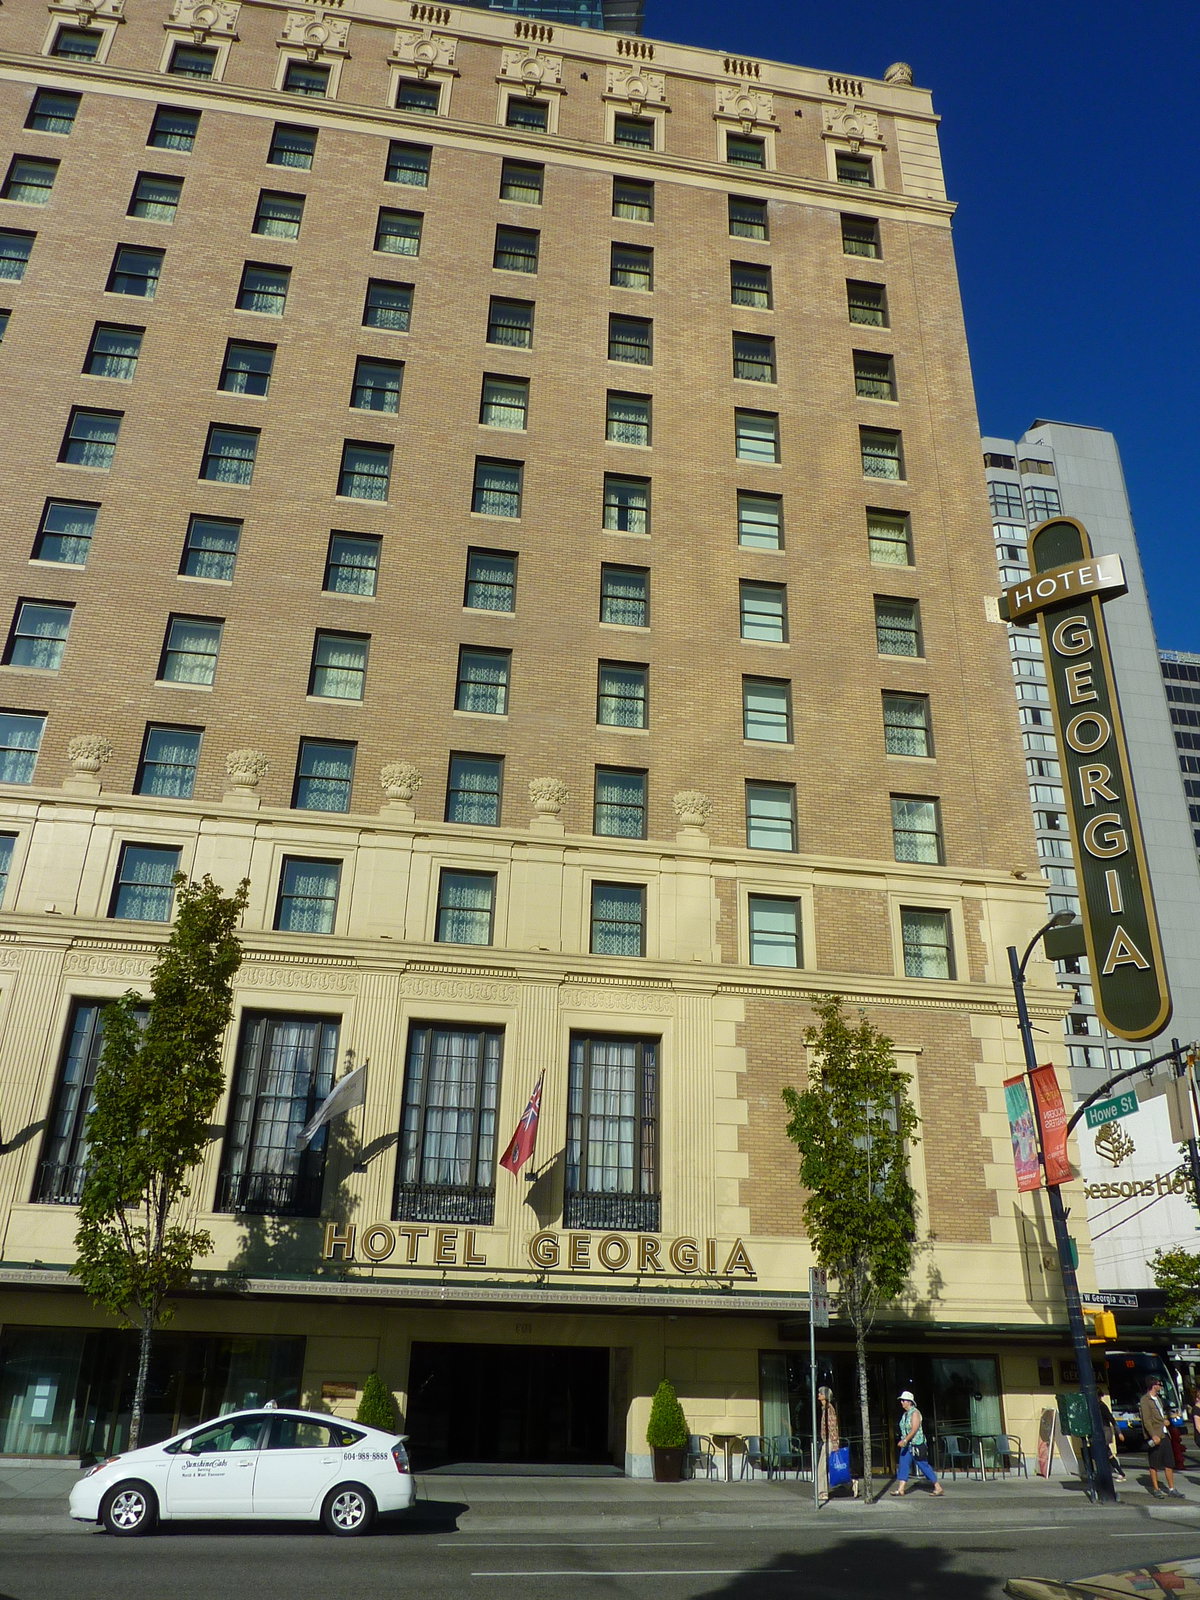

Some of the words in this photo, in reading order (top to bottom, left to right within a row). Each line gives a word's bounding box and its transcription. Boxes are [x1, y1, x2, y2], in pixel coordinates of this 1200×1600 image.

[1015, 565, 1113, 609] HOTEL
[1052, 615, 1150, 976] GEORGIA
[1090, 1105, 1118, 1124] Howe
[1121, 1096, 1134, 1112] St
[323, 1222, 487, 1264] HOTEL
[529, 1231, 757, 1275] GEORGIA
[1092, 1293, 1117, 1305] Georgia
